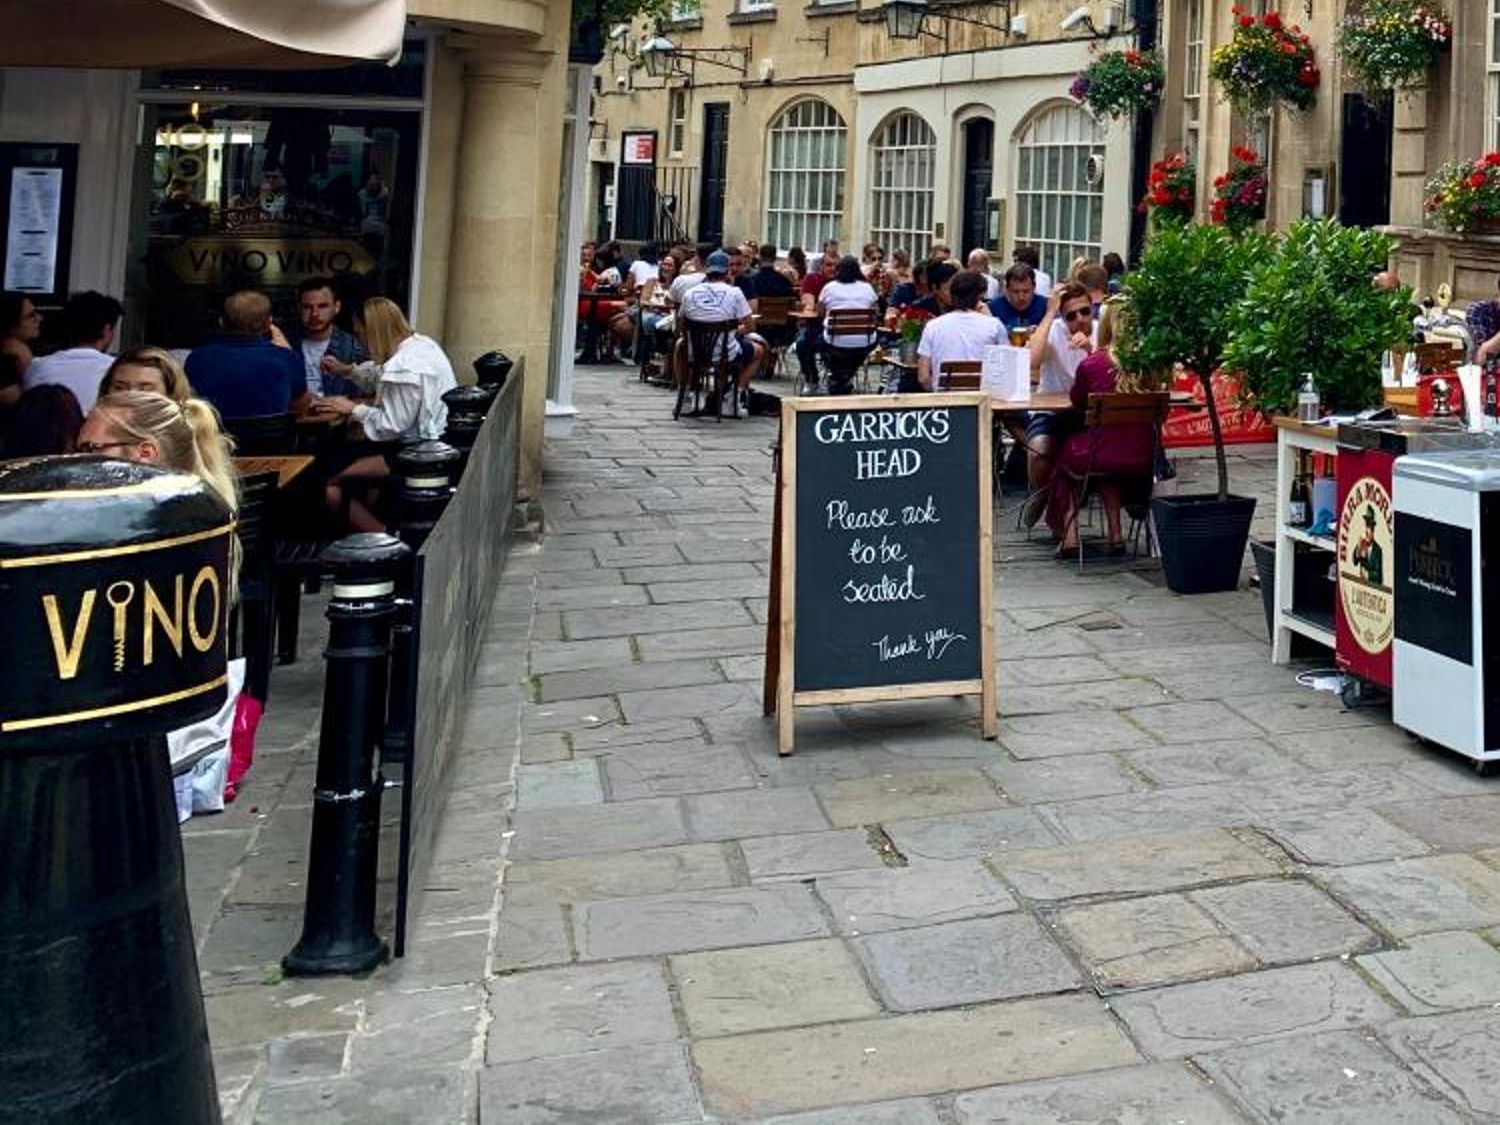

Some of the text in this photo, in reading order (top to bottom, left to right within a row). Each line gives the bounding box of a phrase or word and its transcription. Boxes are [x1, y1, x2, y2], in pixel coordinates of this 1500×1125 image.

[189, 249, 353, 274] VINO VINO
[856, 448, 922, 479] HEAD
[826, 495, 941, 530] Please ask
[849, 534, 907, 564] to be
[843, 565, 926, 603] seated
[41, 565, 220, 680] VINO
[872, 627, 967, 662] Thank you
